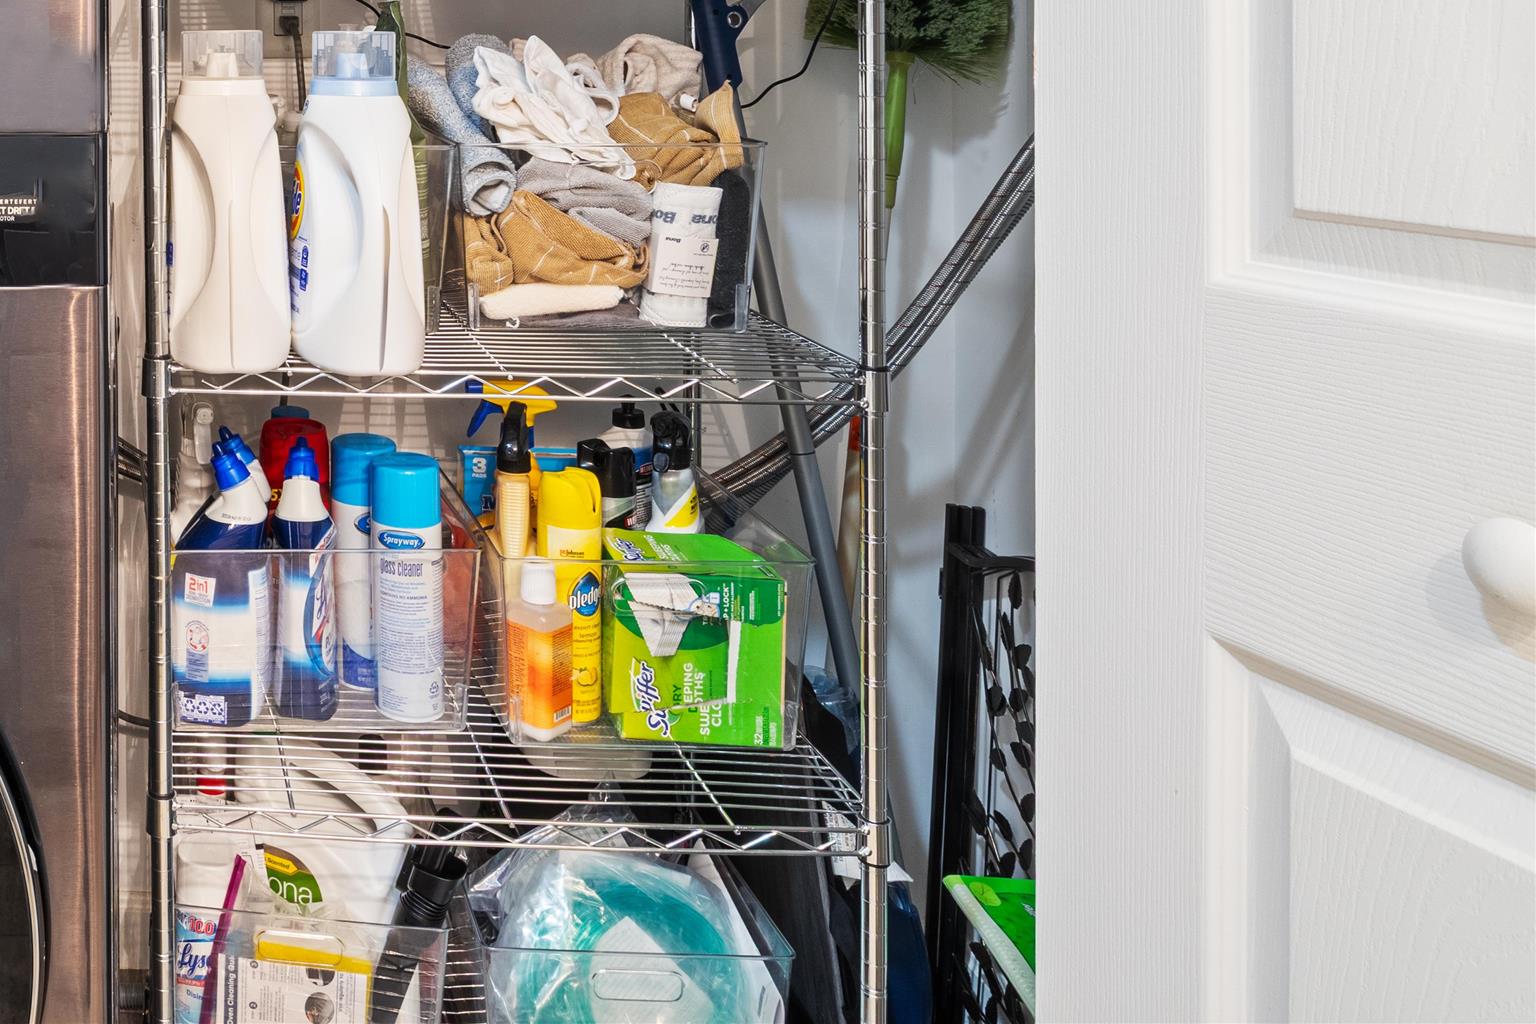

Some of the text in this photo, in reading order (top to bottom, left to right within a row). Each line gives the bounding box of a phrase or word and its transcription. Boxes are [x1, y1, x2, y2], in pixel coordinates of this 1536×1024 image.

[472, 457, 487, 473] 3
[383, 533, 419, 548] Sprayway
[397, 560, 423, 577] cleaner
[227, 973, 236, 1007] Cleaning
